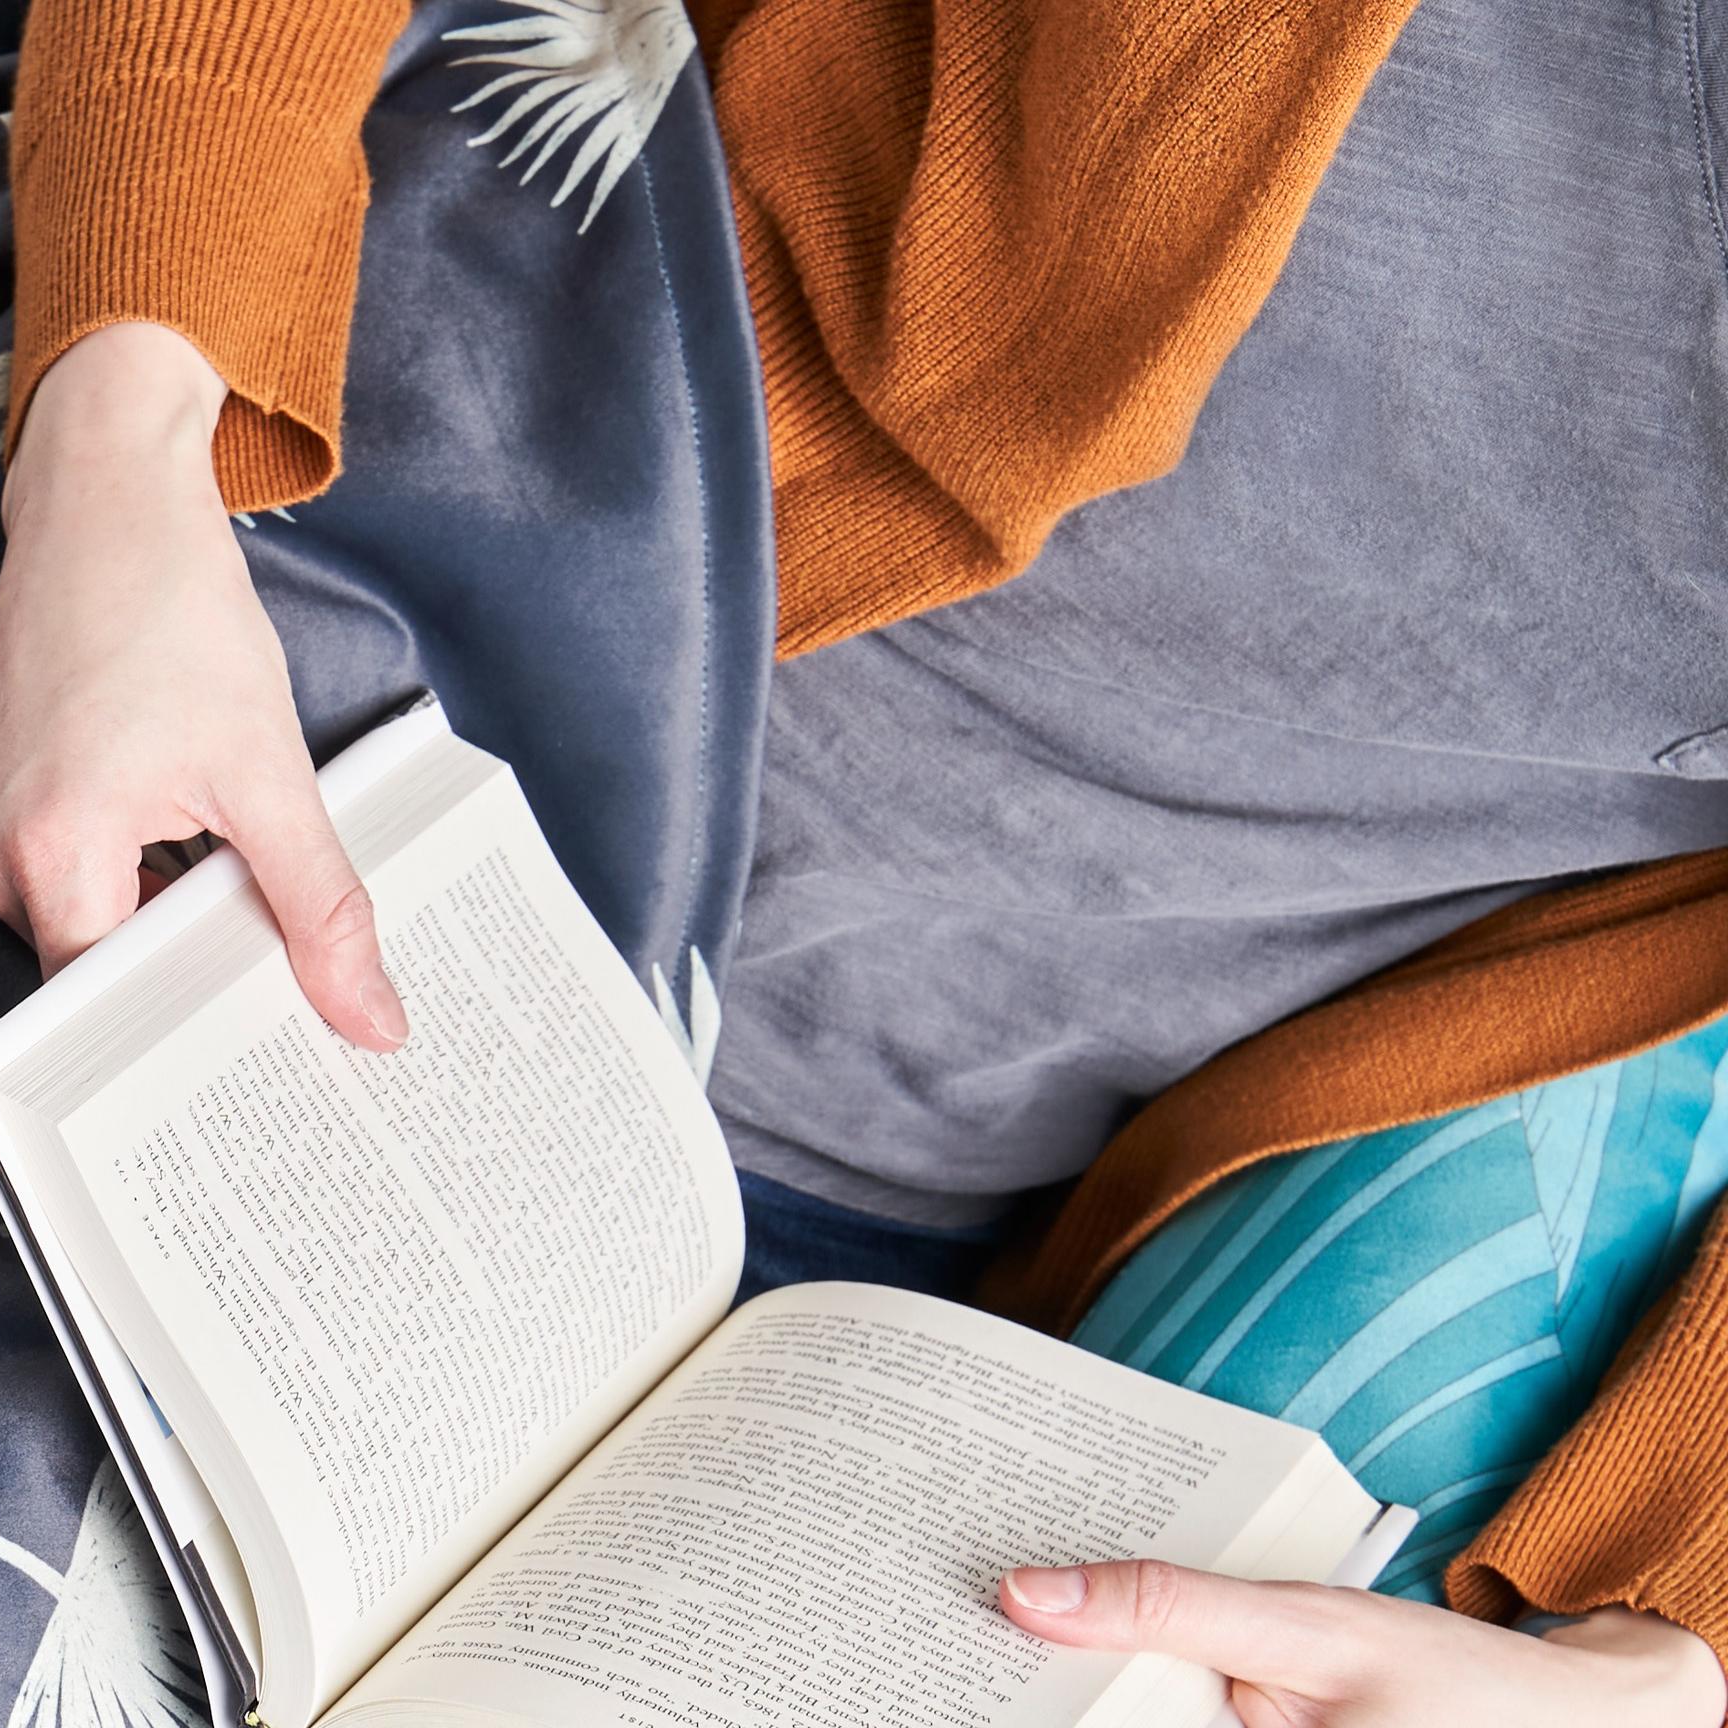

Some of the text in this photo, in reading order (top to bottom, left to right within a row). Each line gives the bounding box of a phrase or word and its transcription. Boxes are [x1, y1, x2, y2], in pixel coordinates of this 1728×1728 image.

[152, 1126, 185, 1187] separate
[112, 1158, 170, 1260] SPACE 175
[144, 1176, 168, 1218] They
[167, 1182, 198, 1236] racism.
[185, 1190, 198, 1208] to
[231, 1182, 266, 1234] among
[196, 1211, 226, 1253] desire
[197, 1239, 227, 1287] White
[263, 1238, 298, 1282] gather
[204, 1280, 227, 1311] had
[224, 1255, 270, 1320] antiracist
[228, 1287, 254, 1324] from
[294, 1285, 344, 1362] voluntarily
[226, 1310, 268, 1375] brethren
[253, 1326, 272, 1355] but
[269, 1324, 289, 1353] The
[267, 1373, 282, 1399] his
[271, 1353, 303, 1409] Whites
[343, 1364, 375, 1416] people
[278, 1398, 299, 1425] and
[293, 1358, 341, 1447] segregation.
[304, 1409, 326, 1448] from
[370, 1415, 393, 1460] Black
[296, 1430, 327, 1483] Frazier
[967, 1427, 1032, 1460] Johnson
[324, 1449, 341, 1478] not
[340, 1448, 364, 1498] always
[339, 1479, 366, 1547] separate,
[360, 1502, 374, 1529] not
[389, 1462, 415, 1543] Whenever
[326, 1483, 353, 1554] violence,
[371, 1532, 379, 1547] is
[361, 1549, 370, 1568] to
[398, 1537, 408, 1577] from
[521, 1589, 543, 1599] be
[545, 1591, 564, 1600] to
[557, 1581, 582, 1591] of
[587, 1585, 620, 1598] care
[496, 1599, 539, 1609] After
[565, 1593, 602, 1609] land
[603, 1602, 663, 1624] needed
[626, 1594, 660, 1610] take
[436, 1619, 497, 1631] General
[536, 1612, 592, 1631] Edwin
[590, 1625, 621, 1639] war
[665, 1621, 701, 1640] they
[668, 1606, 711, 1631] labor,
[460, 1640, 504, 1650] exists
[540, 1626, 582, 1642] Civil
[586, 1637, 614, 1650] the
[617, 1616, 694, 1652] Savannah,
[623, 1634, 643, 1645] of
[702, 1636, 737, 1653] said
[715, 1627, 745, 1642] our
[750, 1641, 769, 1652] of
[426, 1650, 517, 1665] community
[507, 1644, 600, 1673] community
[616, 1646, 635, 1657] of
[639, 1653, 684, 1675] midst
[644, 1641, 713, 1673] secretary
[696, 1647, 715, 1659] in
[707, 1599, 991, 1724] whites or in colonies by yourselves?”
[774, 1651, 811, 1672] fruit
[522, 1660, 610, 1693] industrious
[605, 1670, 643, 1688] such
[717, 1656, 772, 1686] leaders
[740, 1649, 797, 1682] Frazier,
[815, 1670, 842, 1687] the
[686, 1673, 713, 1689] the
[717, 1685, 735, 1697] in
[775, 1680, 819, 1707] Black
[848, 1685, 883, 1704] reap
[615, 1688, 700, 1728] voluntarily
[646, 1686, 675, 1705] “no
[740, 1694, 781, 1720] 1865,
[751, 1686, 785, 1704] and
[801, 1678, 870, 1715] Garrison
[886, 1703, 934, 1728] could
